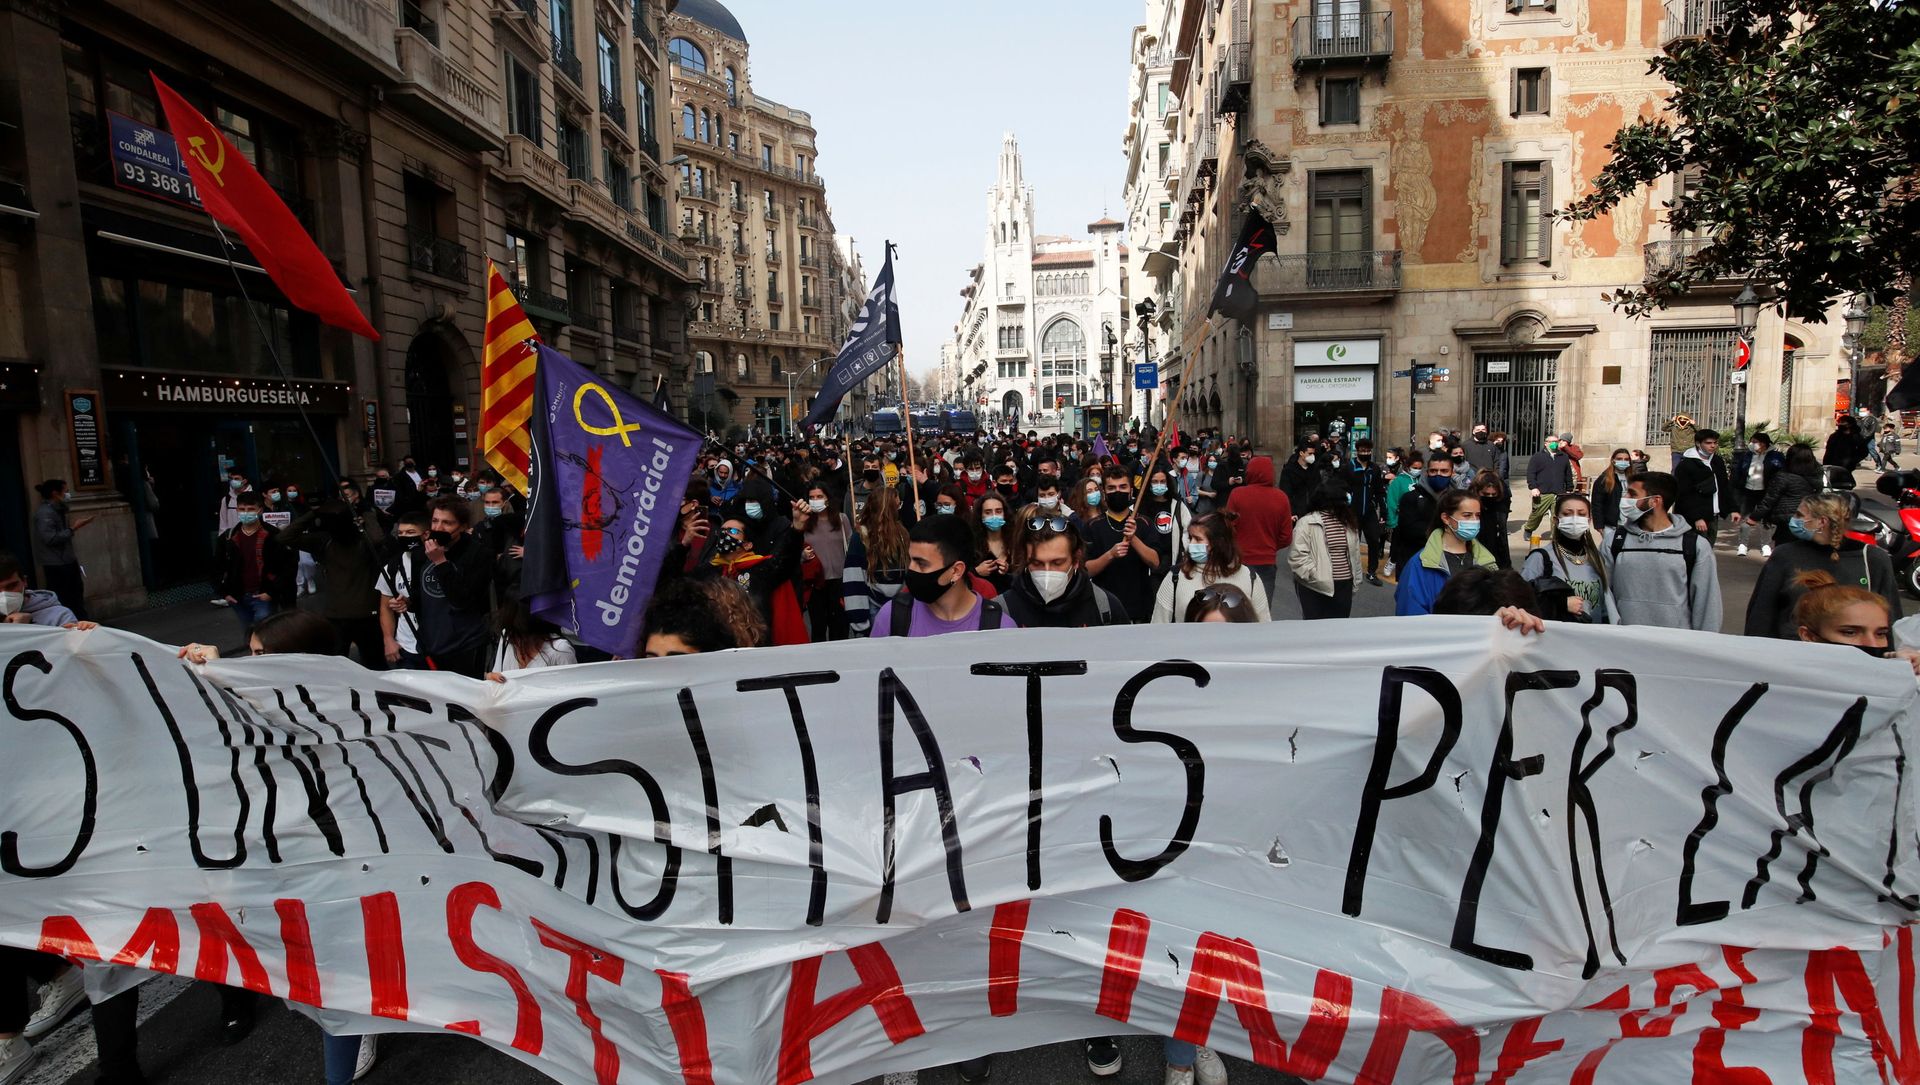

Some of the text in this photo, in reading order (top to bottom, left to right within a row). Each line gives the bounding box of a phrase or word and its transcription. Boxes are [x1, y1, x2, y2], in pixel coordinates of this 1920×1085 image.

[118, 140, 172, 166] CONDALREAL
[123, 162, 146, 183] 93
[150, 170, 181, 194] 368
[157, 384, 310, 405] HAMBURGUESERIA
[595, 436, 674, 627] democràcia!
[1341, 665, 1638, 980] PER
[1677, 682, 1868, 926] LA
